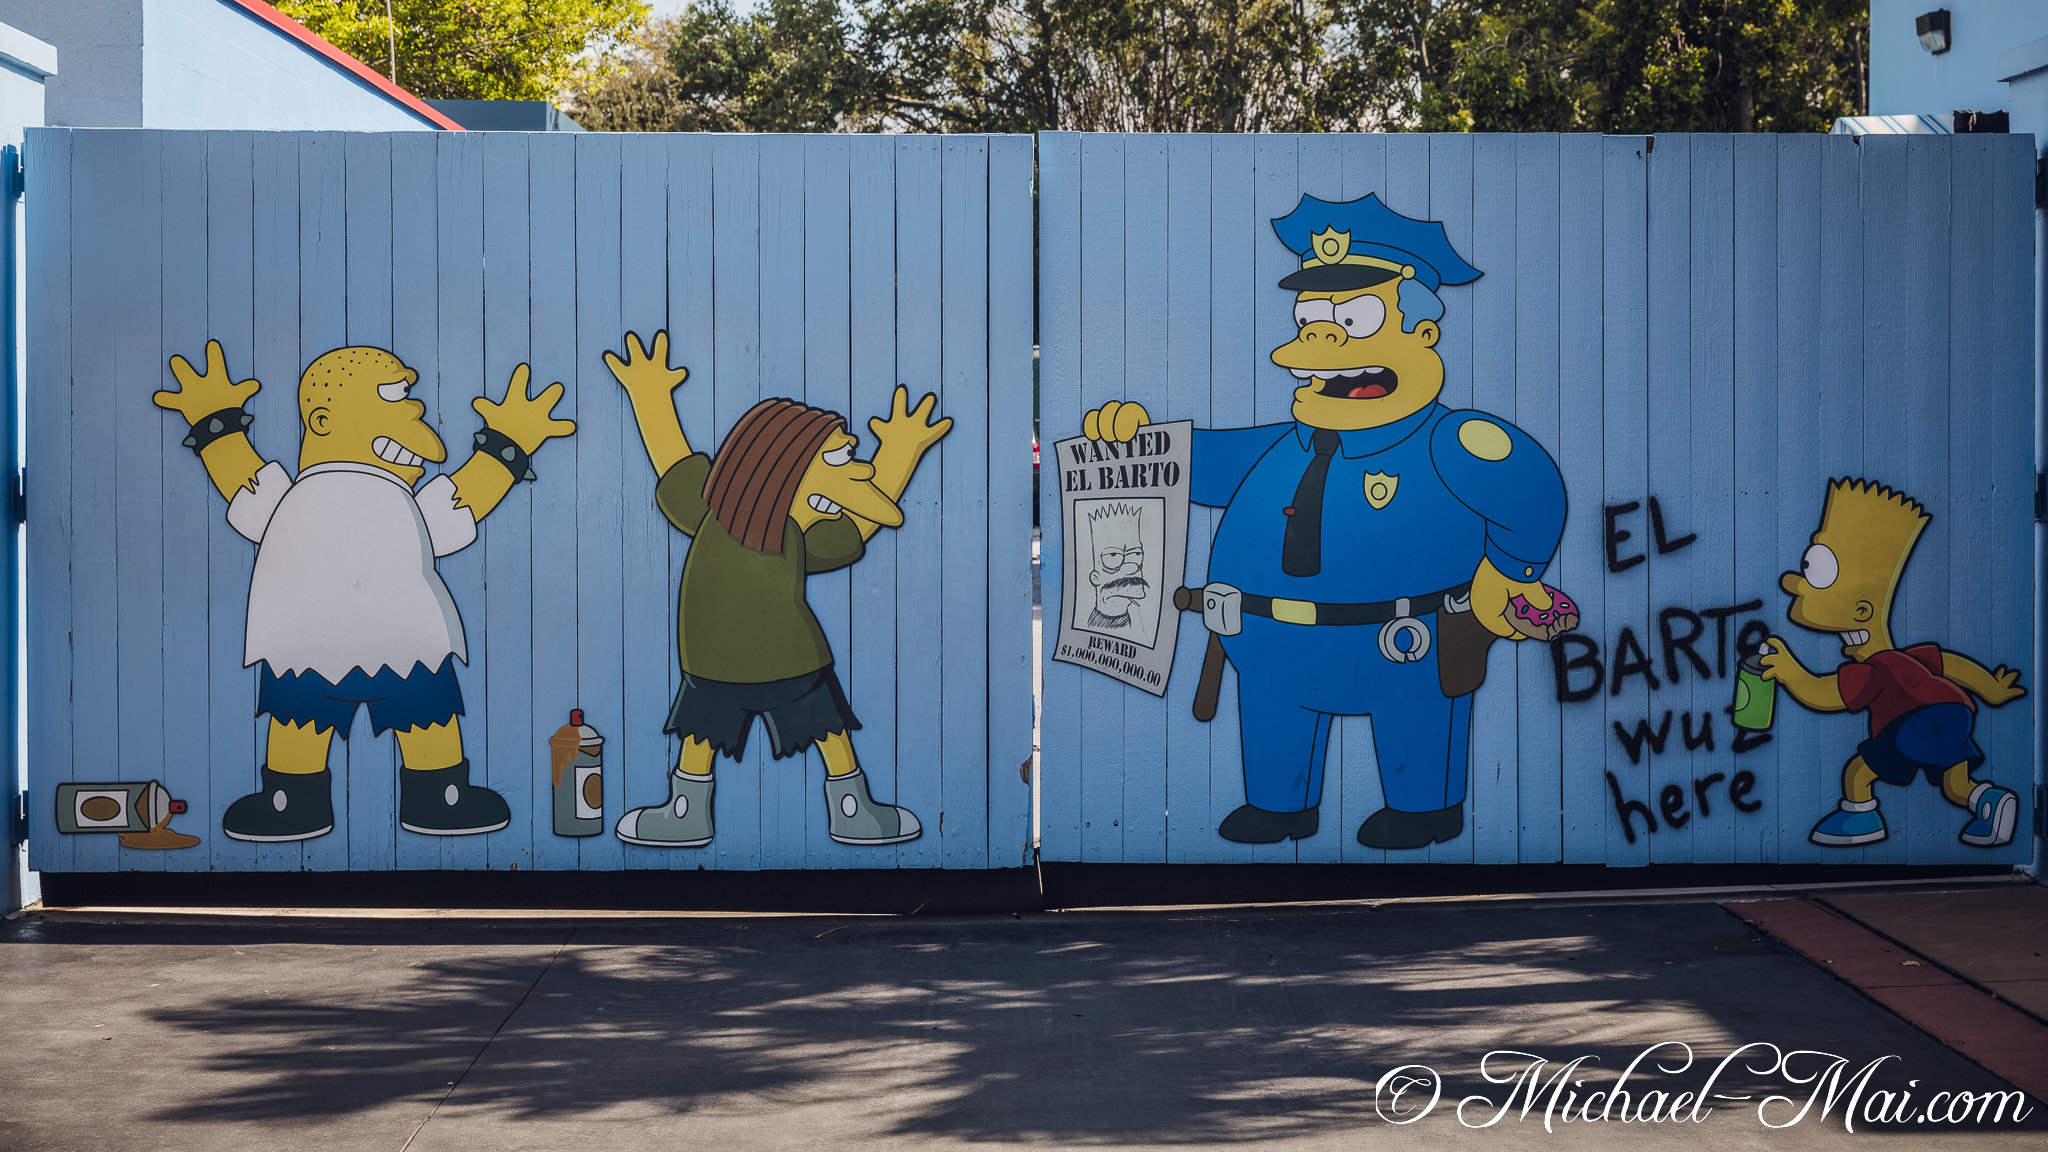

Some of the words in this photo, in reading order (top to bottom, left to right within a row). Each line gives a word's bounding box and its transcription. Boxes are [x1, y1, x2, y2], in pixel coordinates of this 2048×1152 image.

[1070, 430, 1171, 465] WANTED
[1065, 468, 1092, 492] EL
[1098, 461, 1180, 489] BARTO
[1604, 495, 1698, 573] EL
[1060, 643, 1161, 687] $1,000,000,000.00
[1087, 635, 1137, 660] REWARD
[1605, 770, 1763, 844] here
